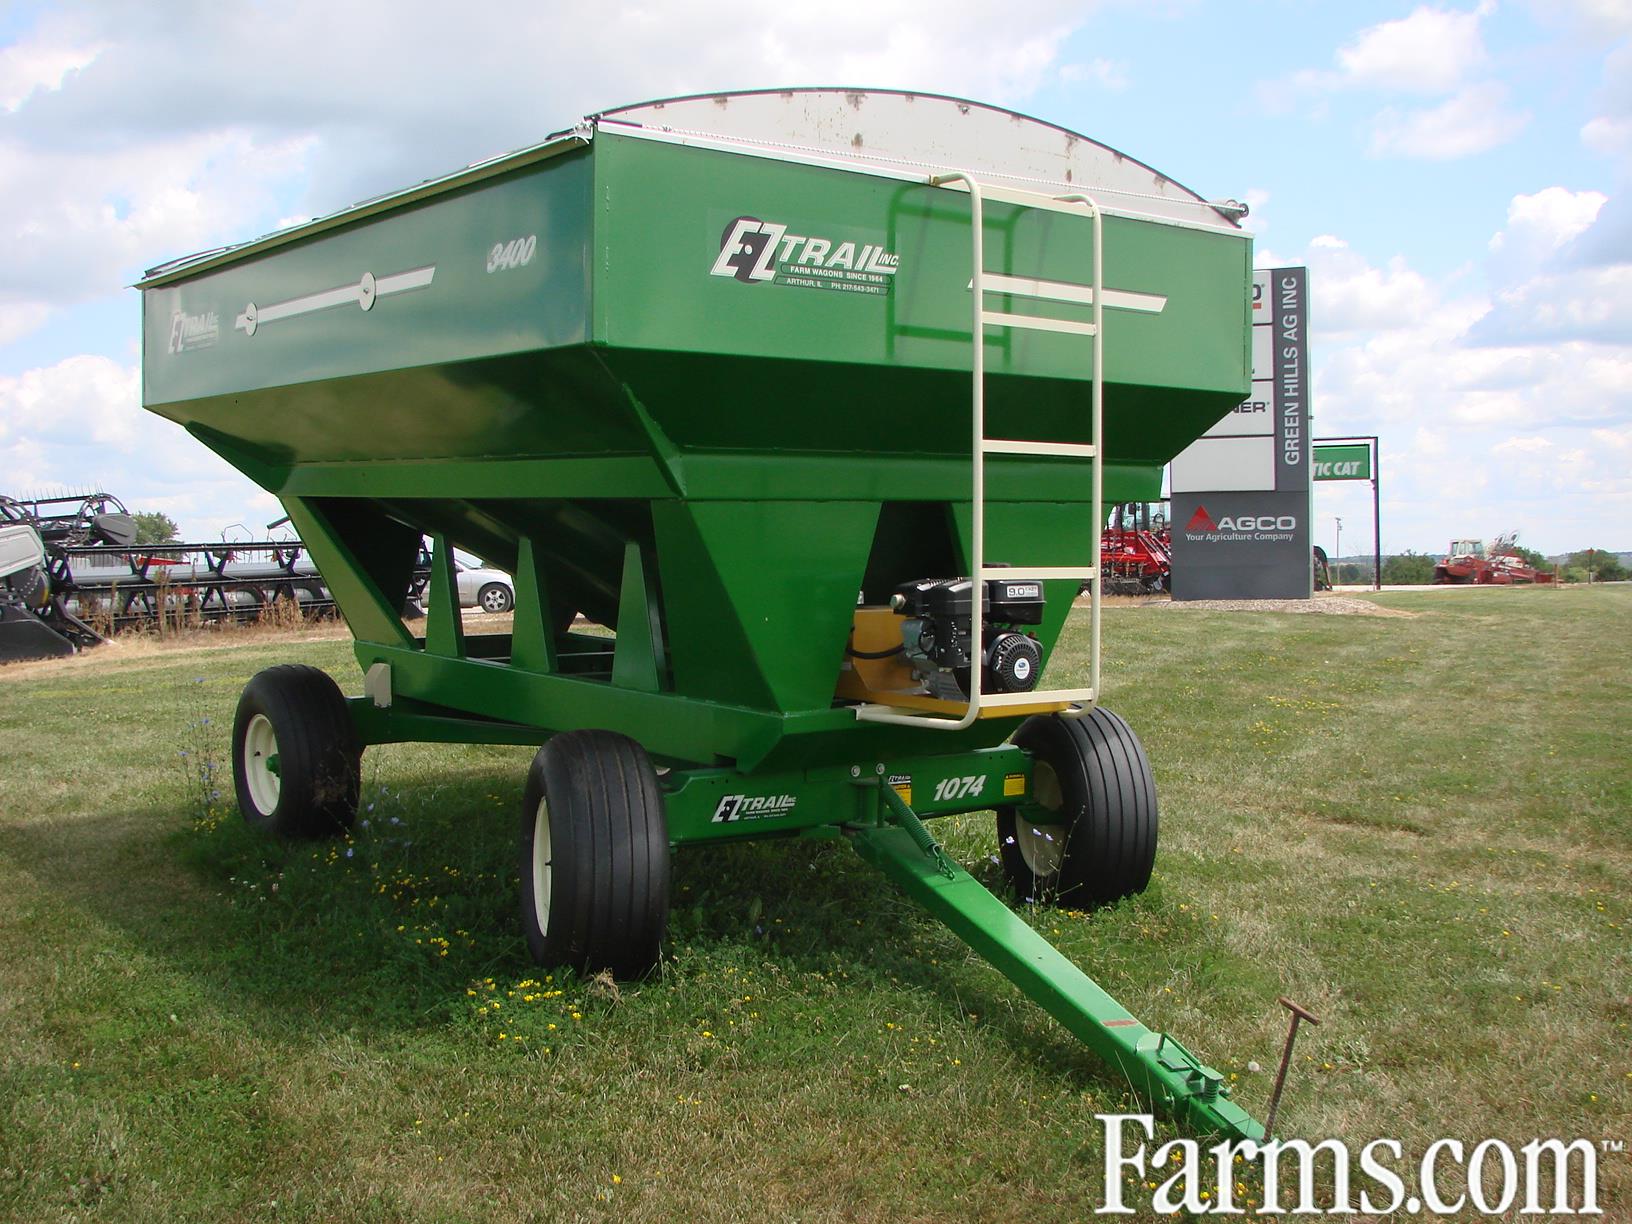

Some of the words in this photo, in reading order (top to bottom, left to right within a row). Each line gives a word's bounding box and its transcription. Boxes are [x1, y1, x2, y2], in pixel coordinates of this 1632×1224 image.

[487, 235, 537, 274] 3400
[779, 234, 898, 275] TRAIL
[790, 265, 811, 275] FARM
[811, 268, 843, 278] WAGONS
[846, 272, 867, 281] SINCE
[1282, 277, 1297, 309] INC
[1283, 315, 1298, 341] AG
[1283, 346, 1299, 397] HILLS
[1284, 402, 1301, 465] GREEN
[1333, 461, 1361, 476] CAT
[1217, 516, 1296, 531] AGCO
[1185, 533, 1204, 541] Your
[1206, 532, 1252, 542] Agriculture
[1254, 532, 1294, 542] Company
[1008, 587, 1025, 597] 9.0
[933, 774, 987, 802] 1074
[741, 795, 796, 812] TRAIL
